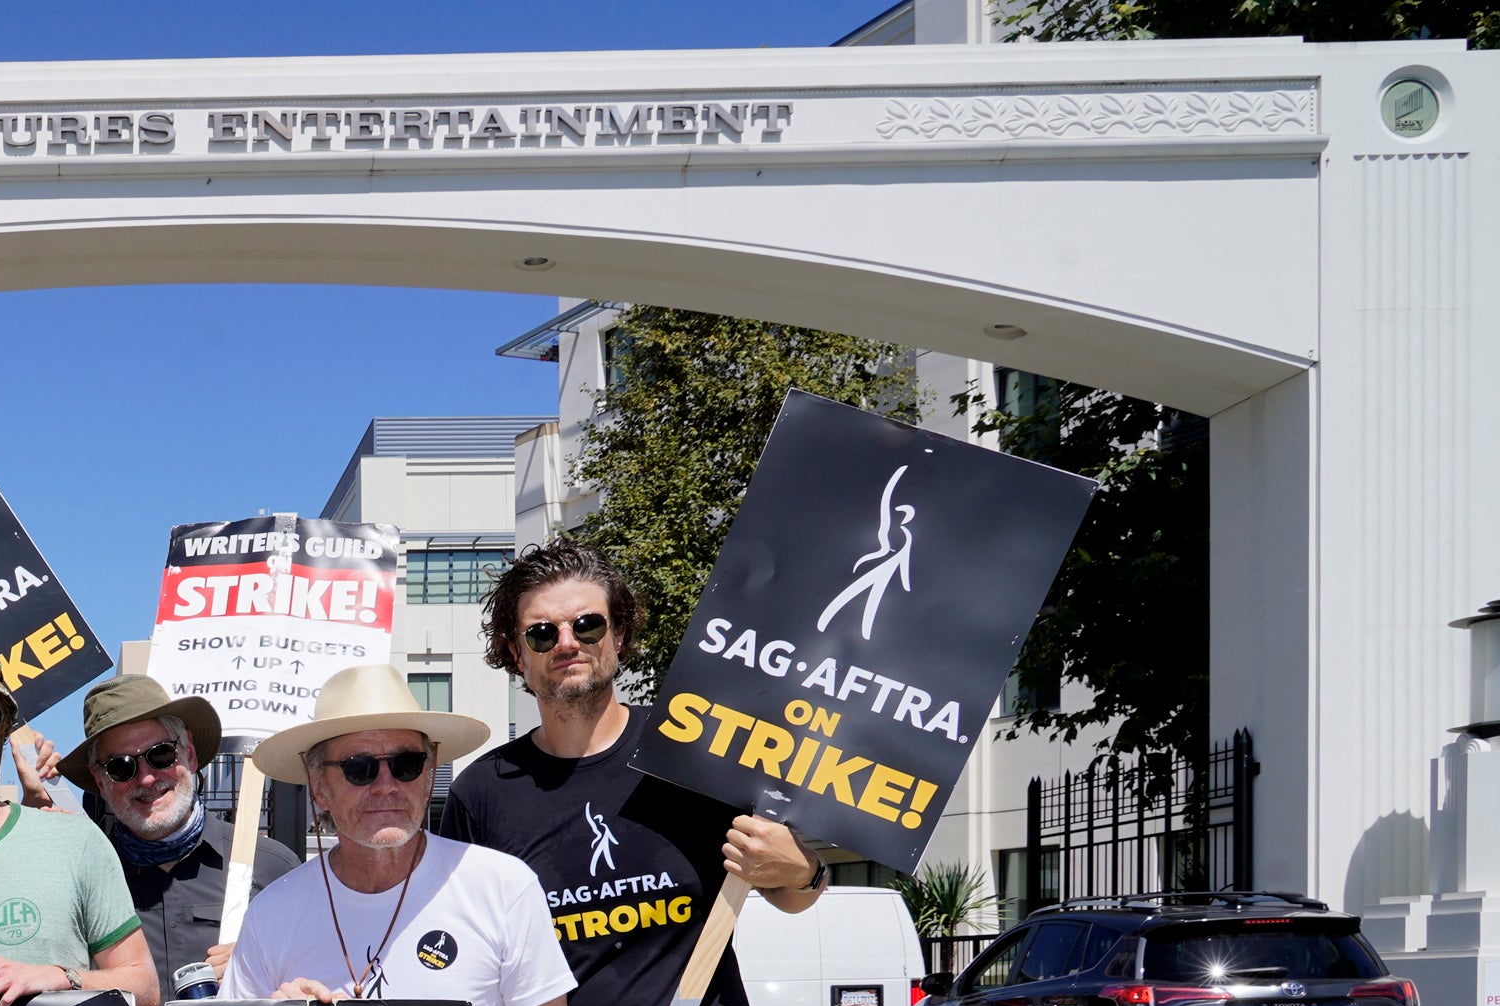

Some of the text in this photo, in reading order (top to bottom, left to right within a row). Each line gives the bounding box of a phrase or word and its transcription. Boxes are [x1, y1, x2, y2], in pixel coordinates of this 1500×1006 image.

[207, 101, 793, 143] ENTERTAINMENT
[305, 535, 383, 560] GUILD
[173, 572, 378, 624] STRIKE!
[178, 634, 367, 657] SHOW BUDGETS
[253, 655, 282, 669] UP
[172, 679, 258, 695] WRITING
[228, 698, 298, 715] DOWN
[784, 699, 841, 738] ON
[658, 692, 938, 830] STRIKE!
